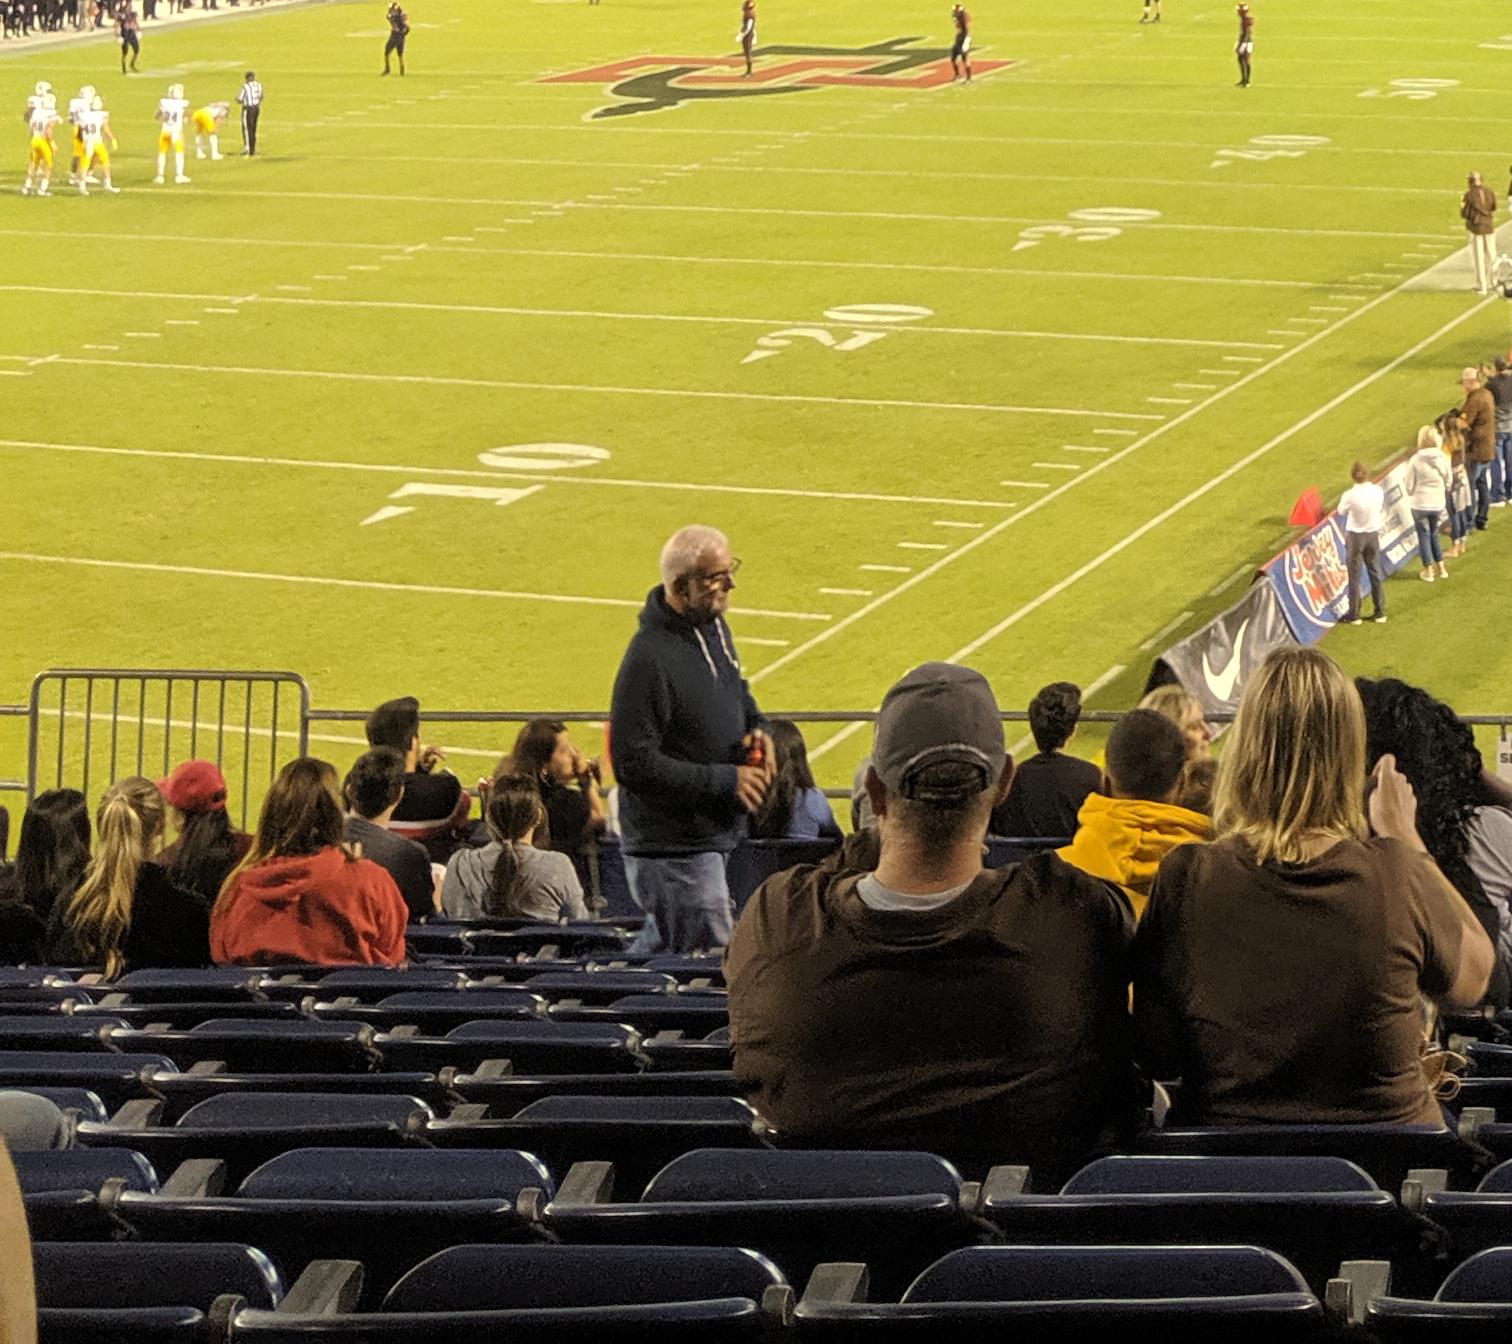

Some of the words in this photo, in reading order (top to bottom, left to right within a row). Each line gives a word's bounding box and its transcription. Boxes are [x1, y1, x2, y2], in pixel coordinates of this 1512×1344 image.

[1018, 206, 1162, 242] 30
[756, 302, 936, 352] 20
[387, 441, 611, 507] 10
